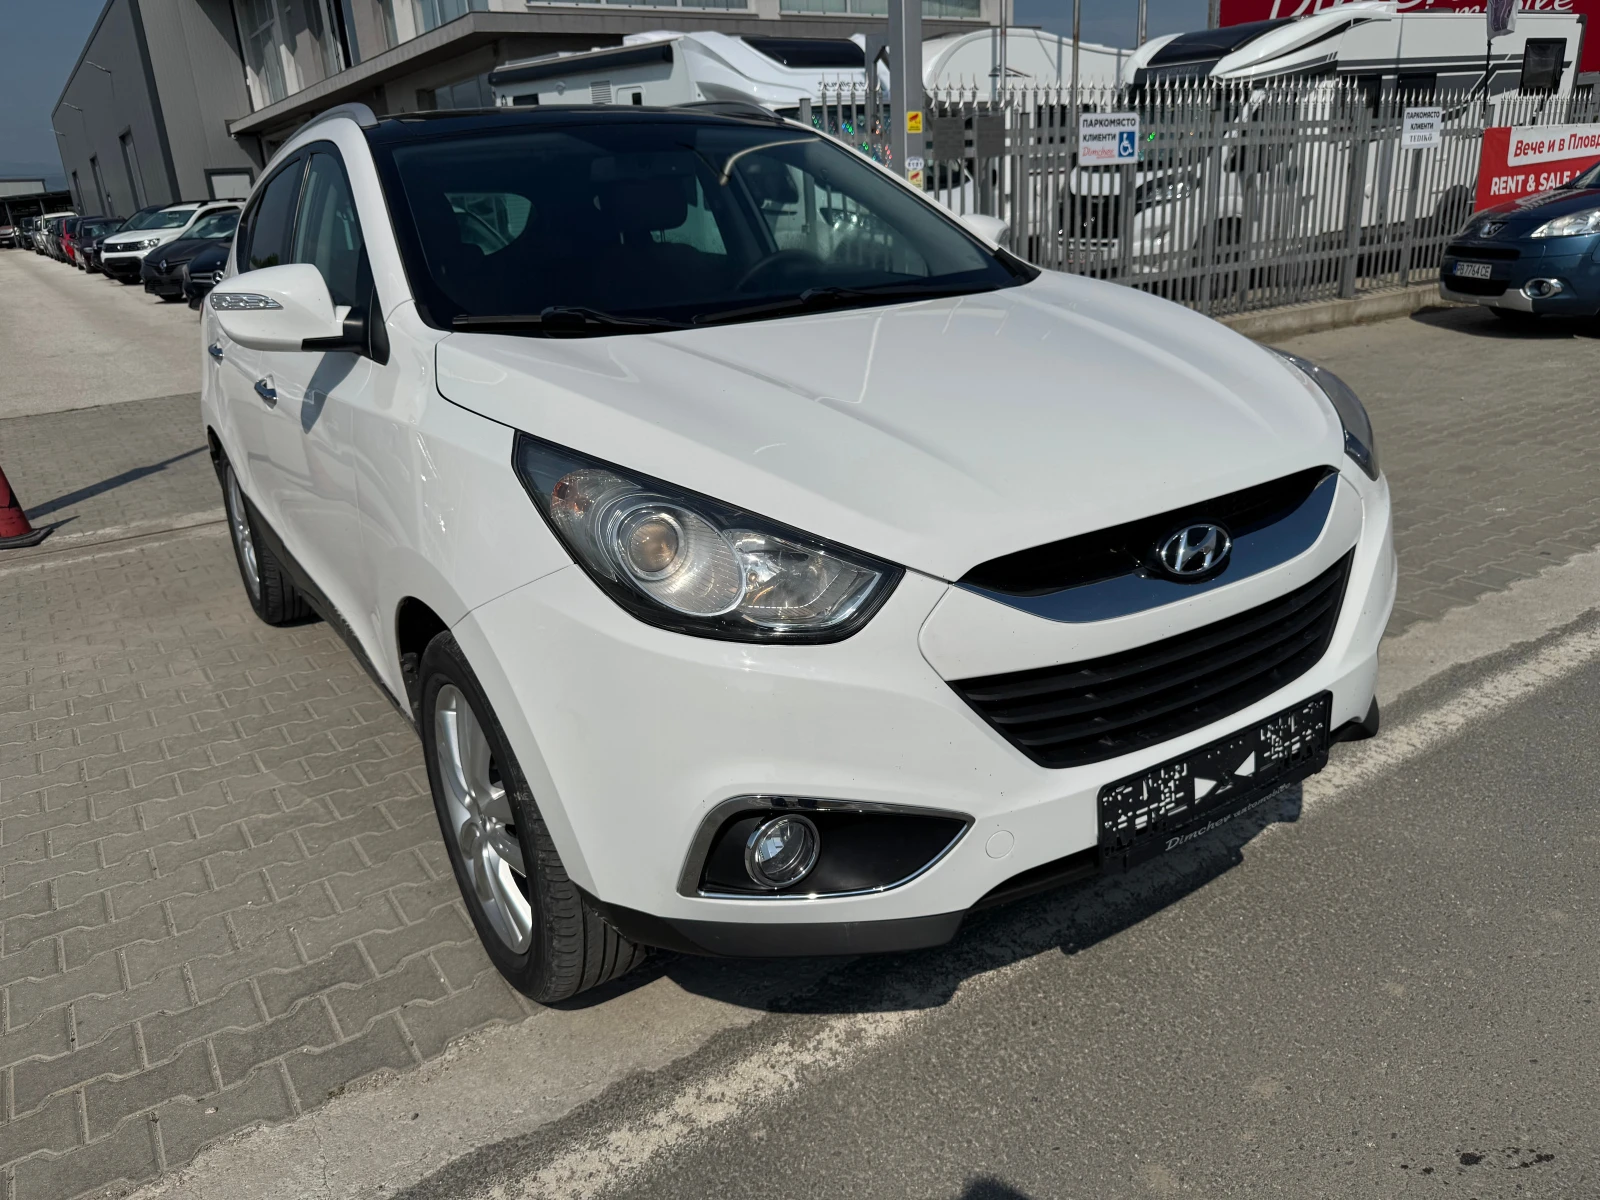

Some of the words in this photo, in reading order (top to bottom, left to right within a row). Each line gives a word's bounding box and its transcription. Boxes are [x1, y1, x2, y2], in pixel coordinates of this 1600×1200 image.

[1406, 111, 1440, 119] ПАРКОМЯСТО
[1082, 118, 1136, 128] ПАРКОМЯСТО
[1410, 122, 1434, 130] КЛИЕНТИ
[1082, 133, 1117, 142] КЛИЕНТИ
[1513, 139, 1545, 157] Вече
[1547, 139, 1556, 153] и
[1558, 138, 1566, 152] в
[1490, 174, 1525, 196] RENT
[1526, 173, 1536, 192] &
[1165, 813, 1231, 851] Dimchev
